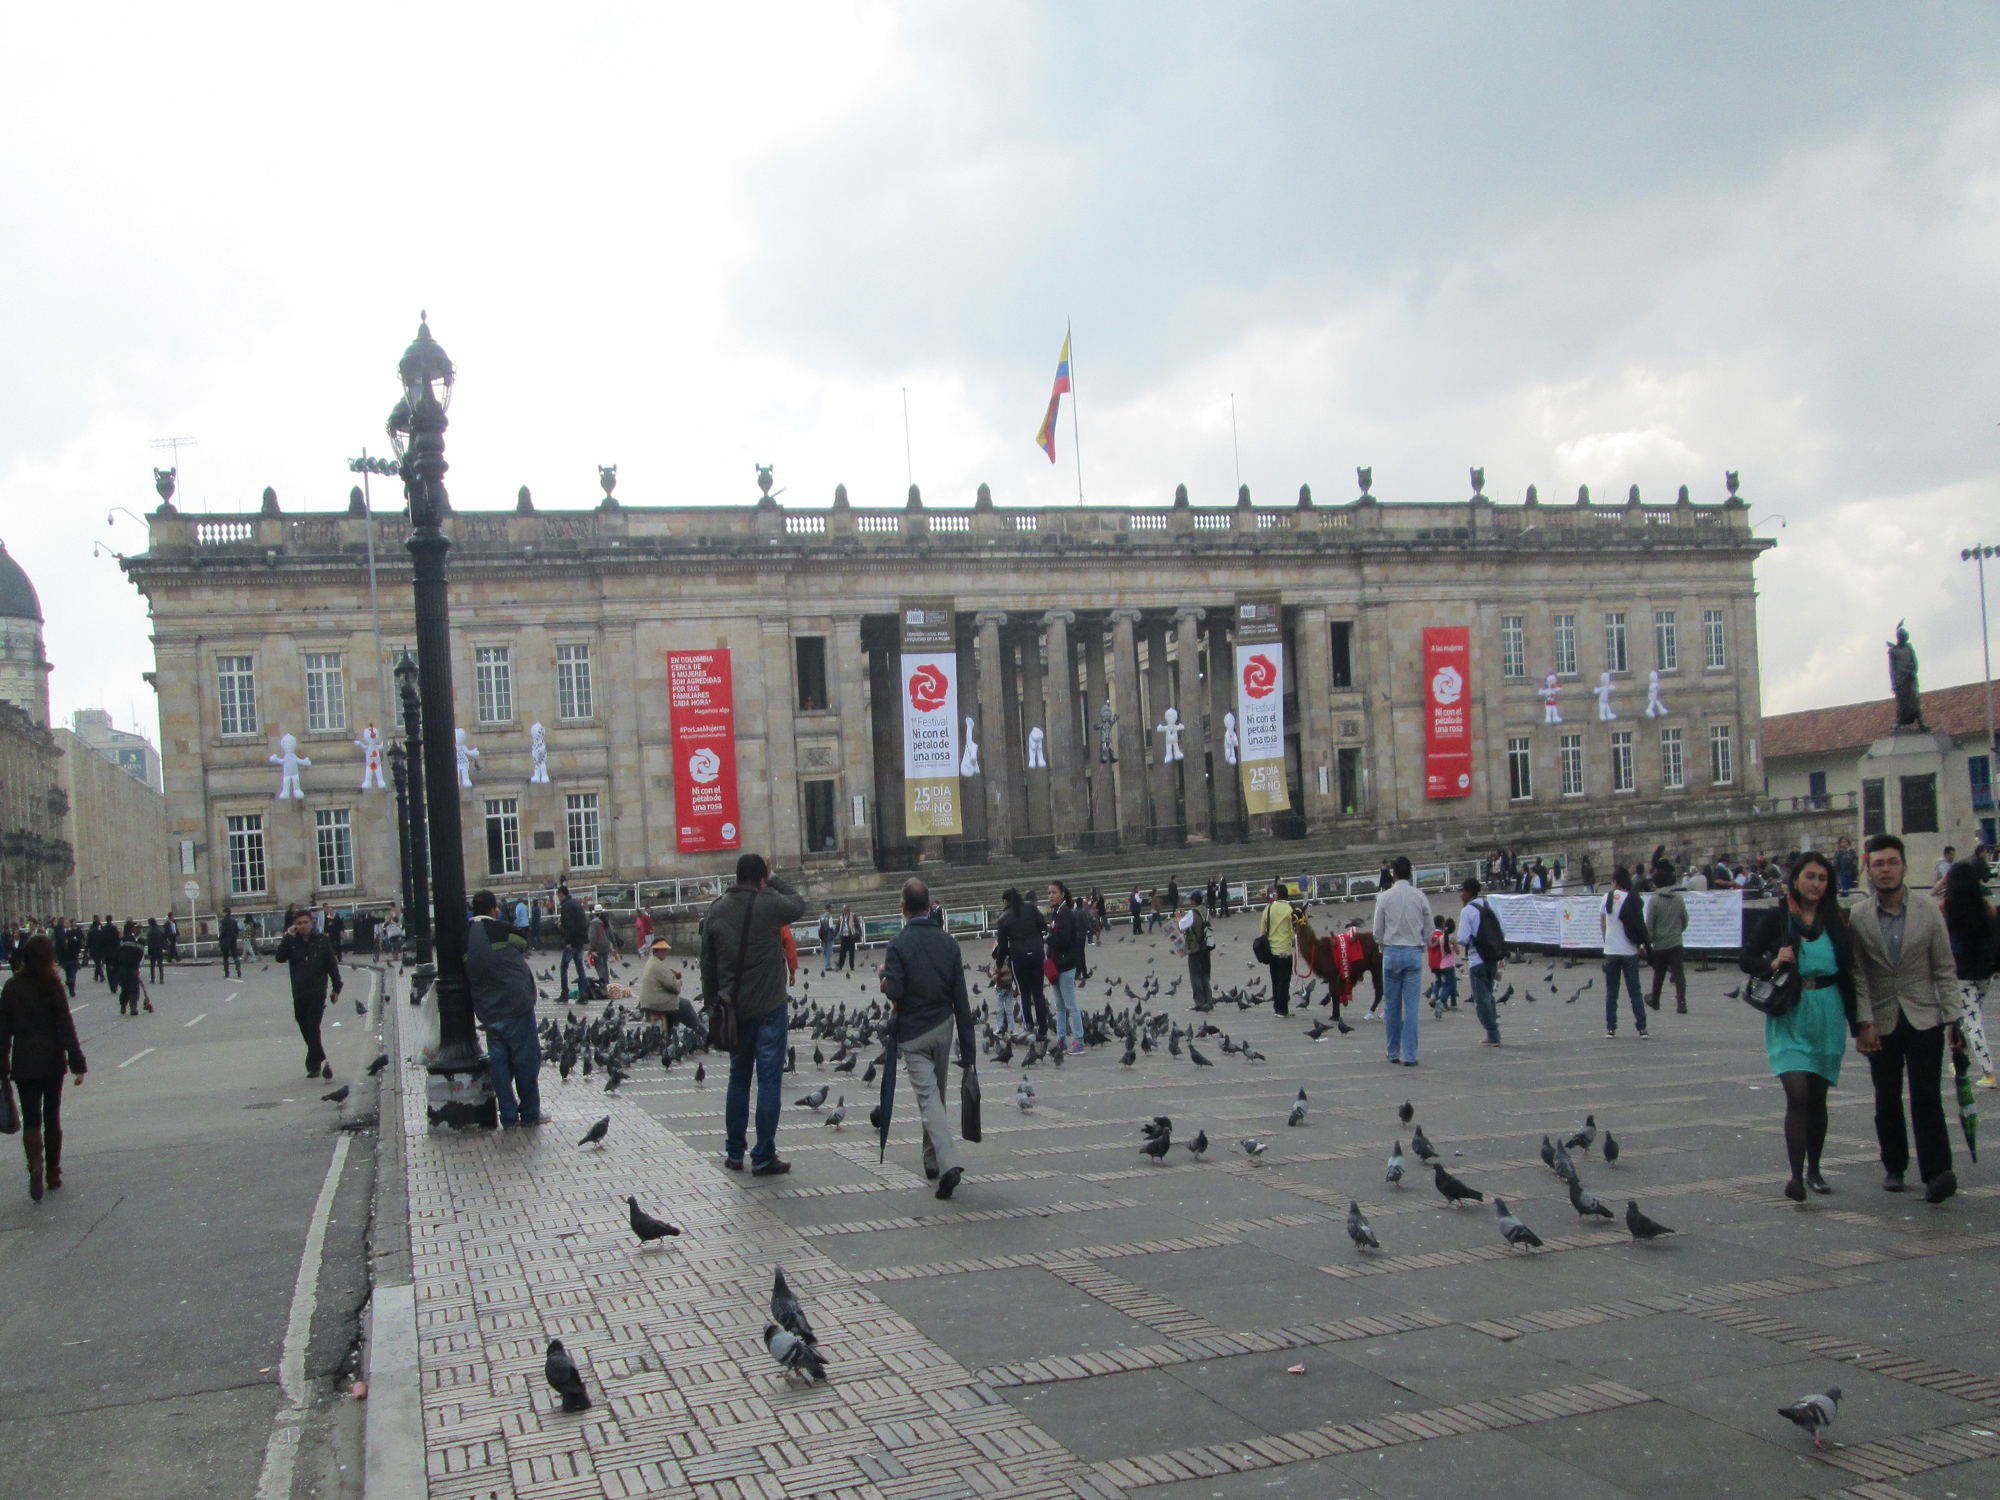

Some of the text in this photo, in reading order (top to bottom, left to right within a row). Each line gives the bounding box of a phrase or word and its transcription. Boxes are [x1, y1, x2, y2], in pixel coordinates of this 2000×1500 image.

[917, 716, 948, 727] Festival
[1247, 715, 1254, 724] Ni
[1270, 712, 1276, 721] el
[1435, 717, 1455, 725] pétalo
[913, 728, 949, 739] Ni con el
[1248, 723, 1276, 736] pétalo de
[914, 739, 949, 752] pétalo de
[1248, 736, 1263, 745] una
[914, 751, 950, 761] una rosa
[1250, 766, 1266, 783] 25
[1267, 763, 1279, 775] DÍA
[692, 787, 699, 795] Ni
[933, 783, 951, 796] DÍA
[1268, 780, 1280, 791] NO
[693, 795, 712, 804] pétalo
[914, 786, 931, 804] 25
[934, 802, 952, 813] NO
